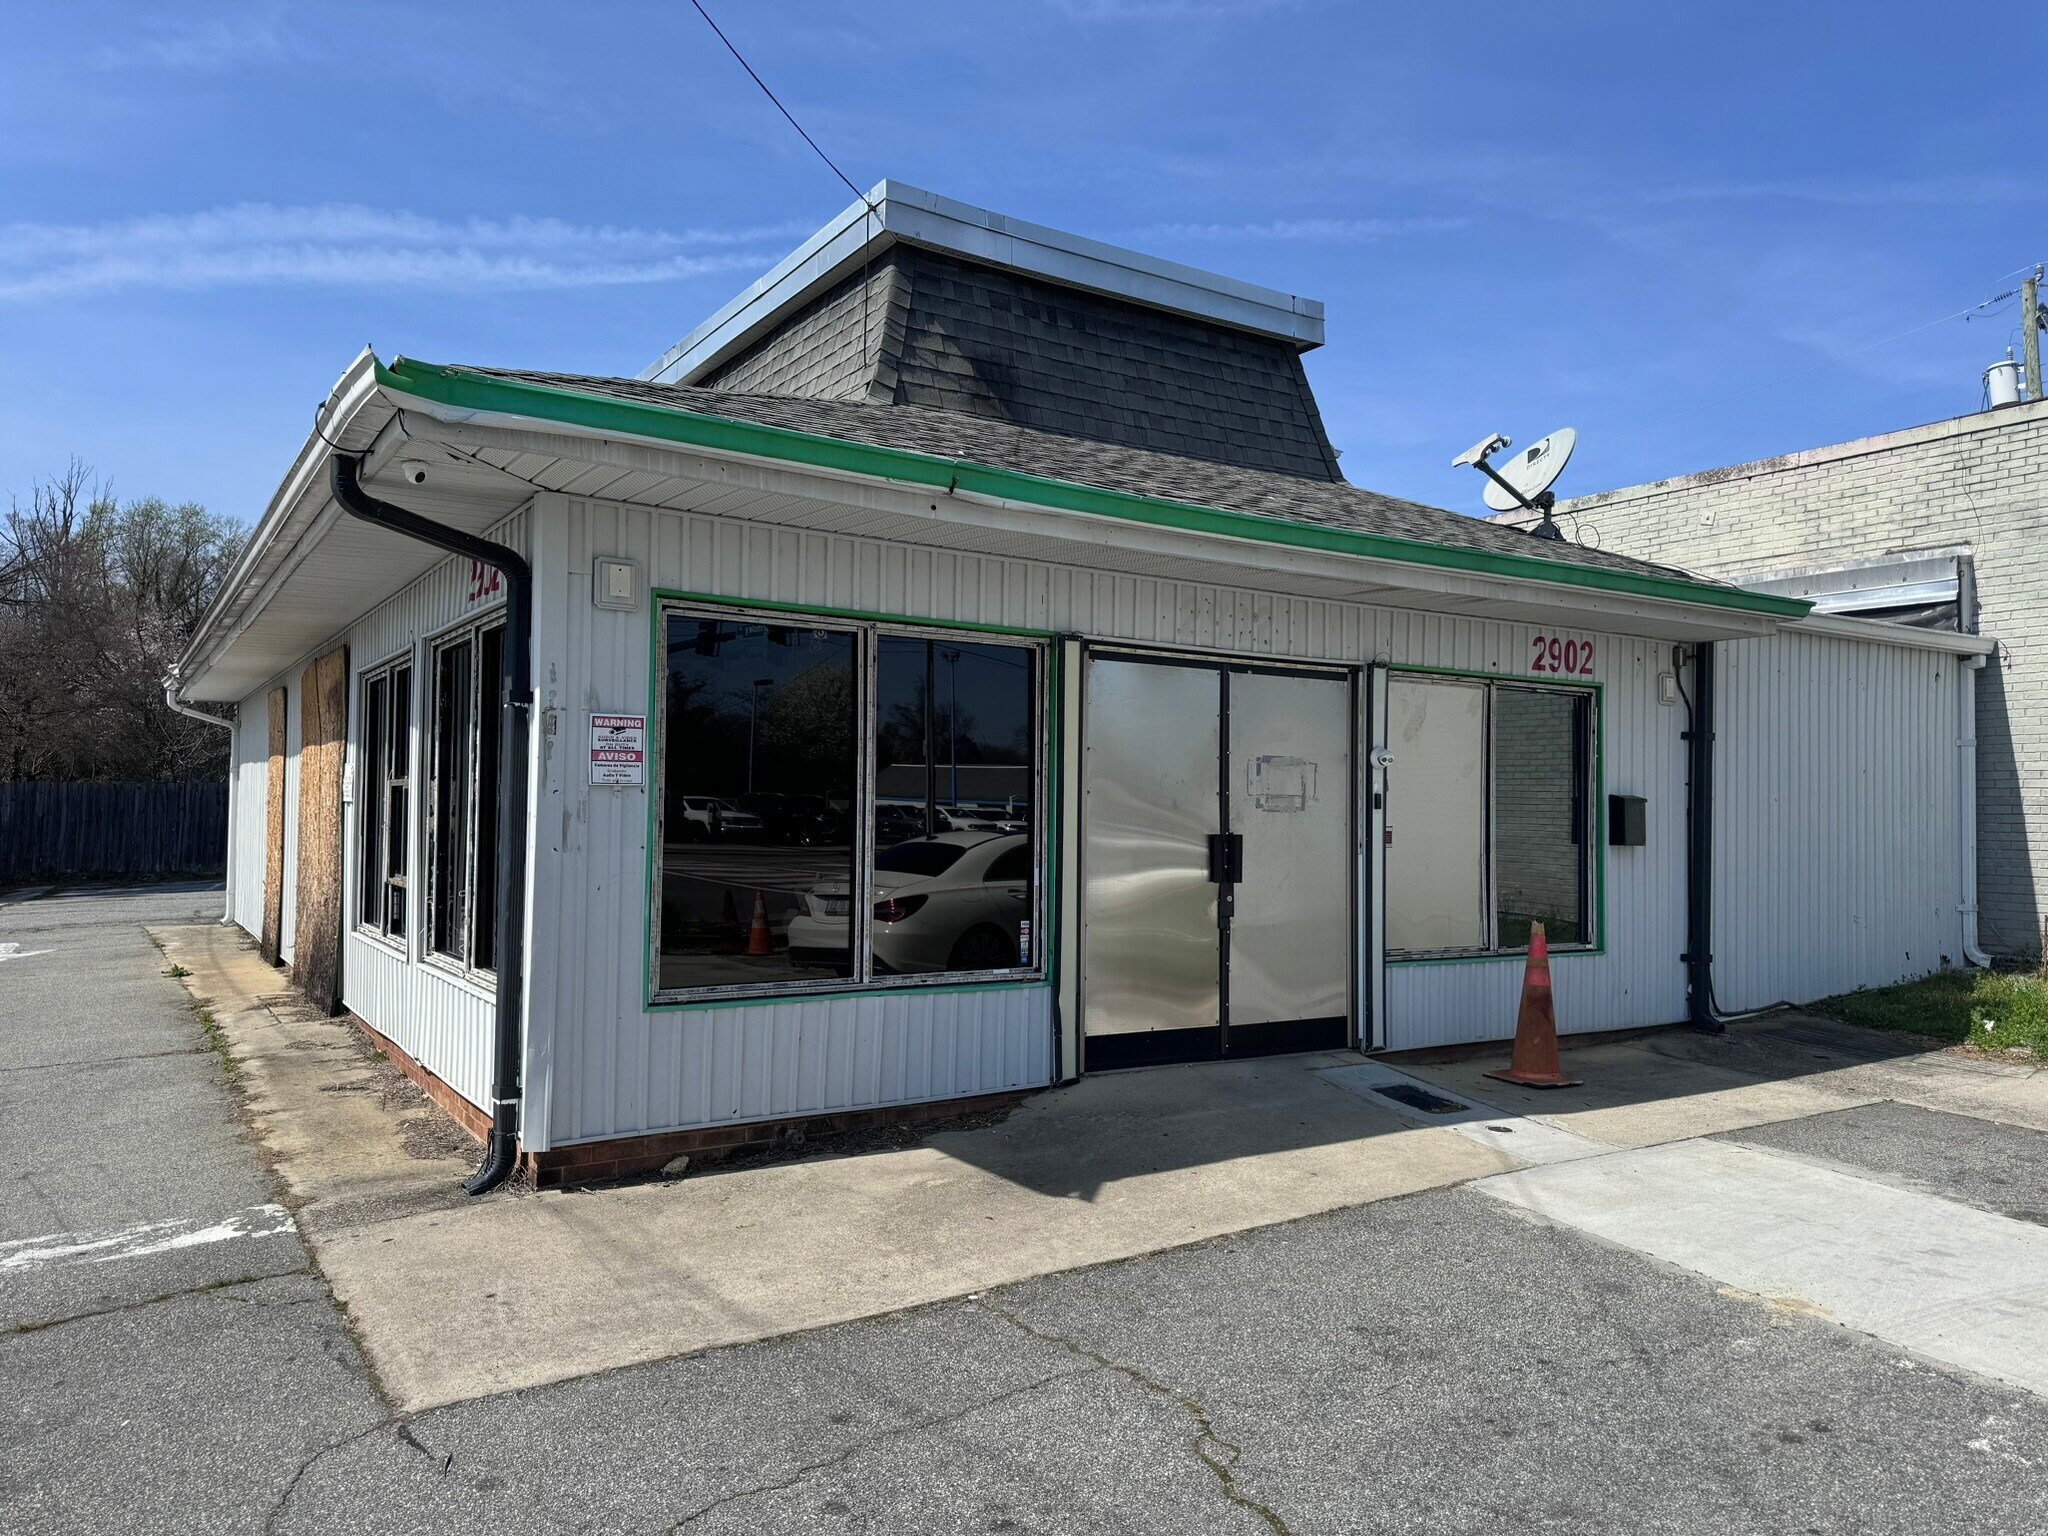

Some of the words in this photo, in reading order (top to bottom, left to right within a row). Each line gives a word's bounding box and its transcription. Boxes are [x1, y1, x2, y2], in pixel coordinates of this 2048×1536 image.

[1526, 453, 1550, 470] DIRECTV
[1531, 635, 1593, 675] 2902
[594, 718, 642, 728] WARNING
[598, 752, 636, 761] AVISO
